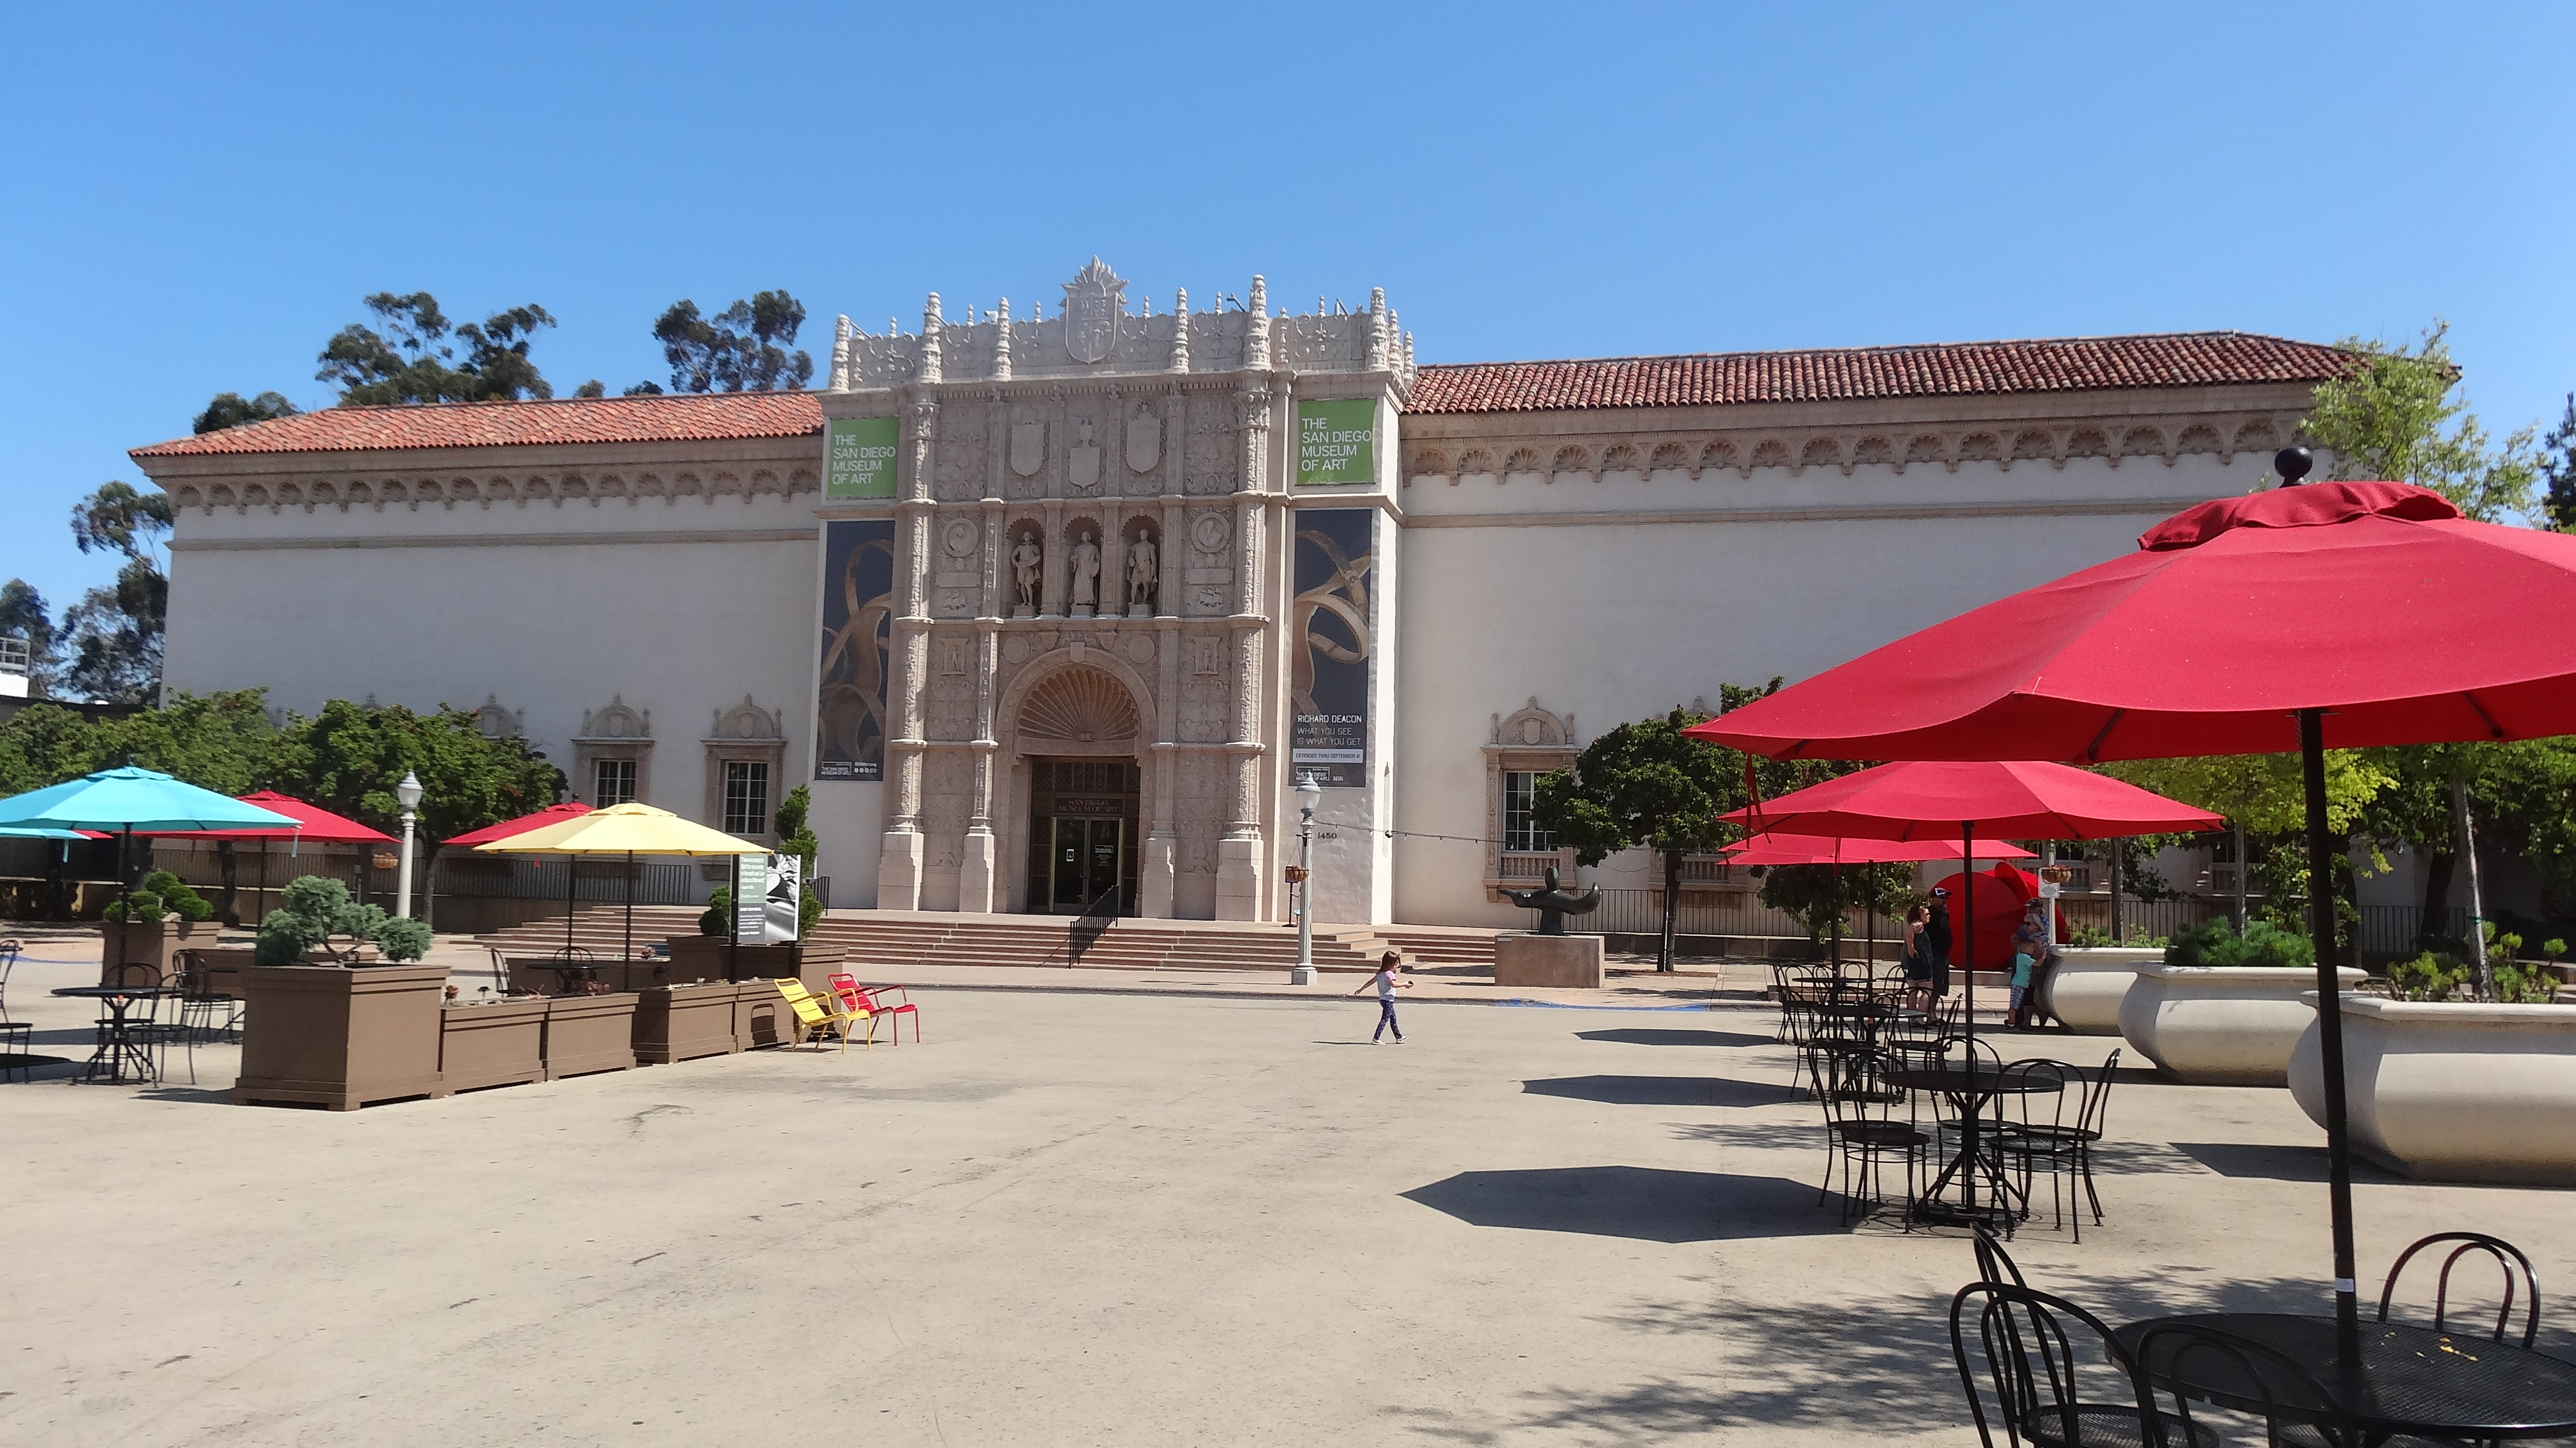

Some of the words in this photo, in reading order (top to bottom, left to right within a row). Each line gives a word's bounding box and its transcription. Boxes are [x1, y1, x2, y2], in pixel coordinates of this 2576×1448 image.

[1302, 418, 1327, 430] THE
[833, 434, 857, 446] THE
[1302, 431, 1329, 444] SAN
[1332, 430, 1372, 443] DIEGO
[833, 448, 858, 459] SAN
[860, 446, 897, 458] DIEGO
[1302, 444, 1357, 457] MUSEUM
[832, 460, 882, 471] MUSEUM
[1302, 459, 1320, 471] OF
[1322, 458, 1348, 470] ART
[832, 474, 849, 485] OF
[850, 473, 874, 484] ART
